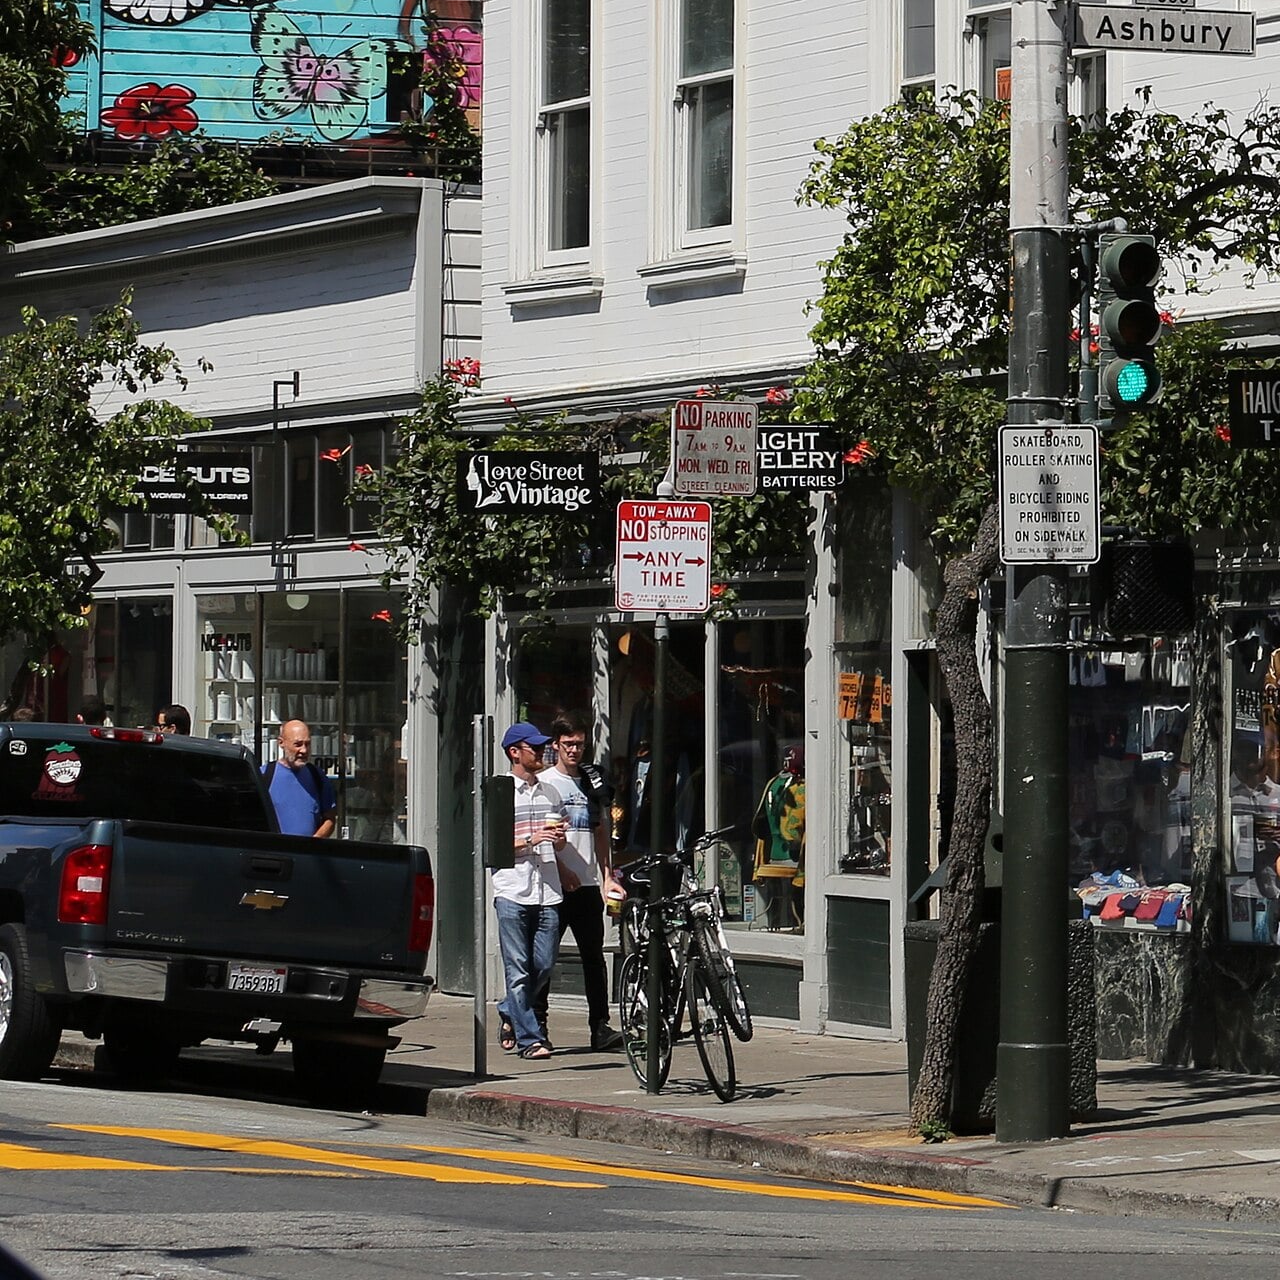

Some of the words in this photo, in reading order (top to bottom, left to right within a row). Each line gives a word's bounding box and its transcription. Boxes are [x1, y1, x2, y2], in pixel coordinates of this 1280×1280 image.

[1096, 15, 1232, 51] Ashbury
[680, 404, 700, 426] NO
[705, 410, 752, 429] PARKING
[1012, 435, 1084, 448] SKATEBOARD,
[1005, 454, 1046, 466] ROLLER
[1050, 454, 1093, 466] SKATING
[477, 455, 527, 488] Love
[529, 460, 585, 481] Street
[763, 475, 836, 488] BATTERIES
[1038, 473, 1060, 485] AND
[681, 481, 710, 491] STREET
[715, 482, 750, 492] CLEANING
[500, 481, 593, 512] Vintage
[1009, 492, 1053, 504] BICYCLE
[1056, 492, 1090, 504] RIDING
[632, 505, 697, 519] TOW-AWAY
[1020, 511, 1080, 523] PROHIBITED
[620, 519, 646, 540] NO
[650, 525, 706, 541] STOPPING
[1015, 530, 1029, 542] ON
[1034, 530, 1085, 542] SIDEWALK
[644, 551, 683, 567] ANY
[640, 571, 685, 587] TIME
[231, 974, 281, 993] 73593B1
